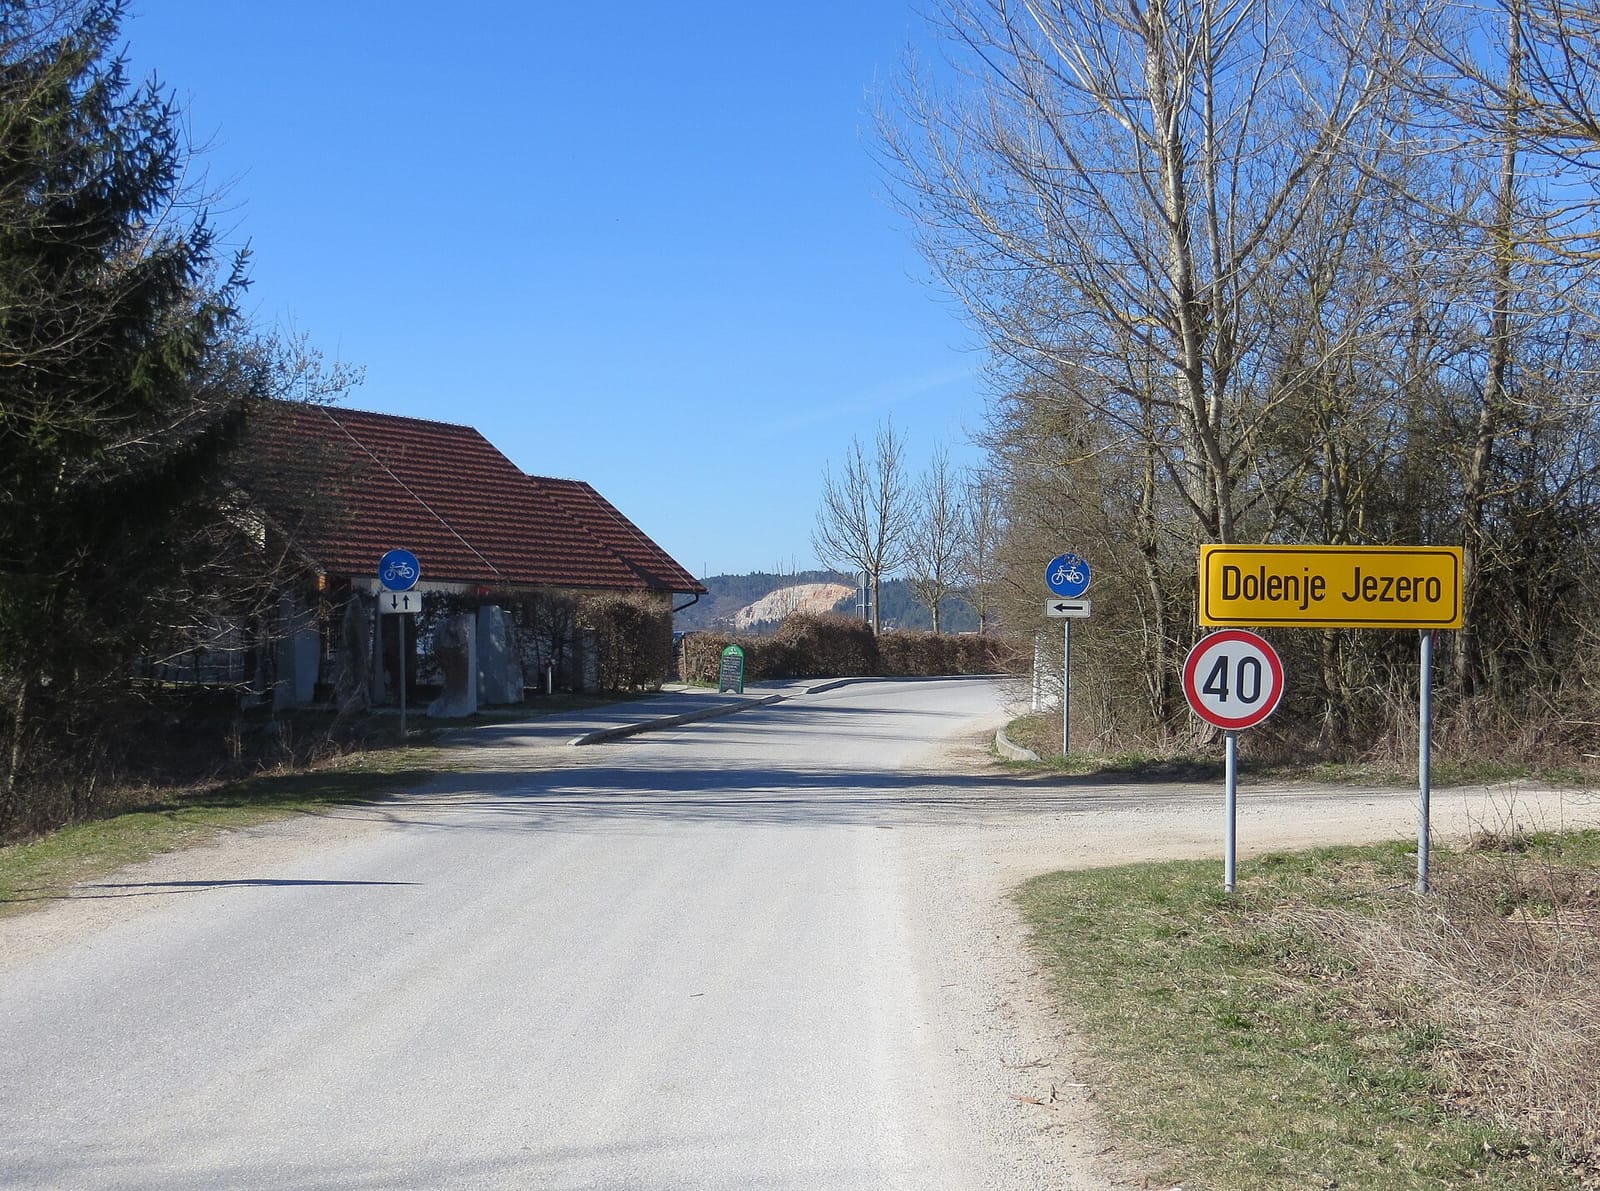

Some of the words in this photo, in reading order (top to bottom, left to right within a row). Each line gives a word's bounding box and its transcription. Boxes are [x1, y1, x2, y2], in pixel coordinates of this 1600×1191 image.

[1222, 566, 1326, 610] Dolenje
[1342, 567, 1441, 602] Jezero
[1202, 656, 1262, 704] 40
